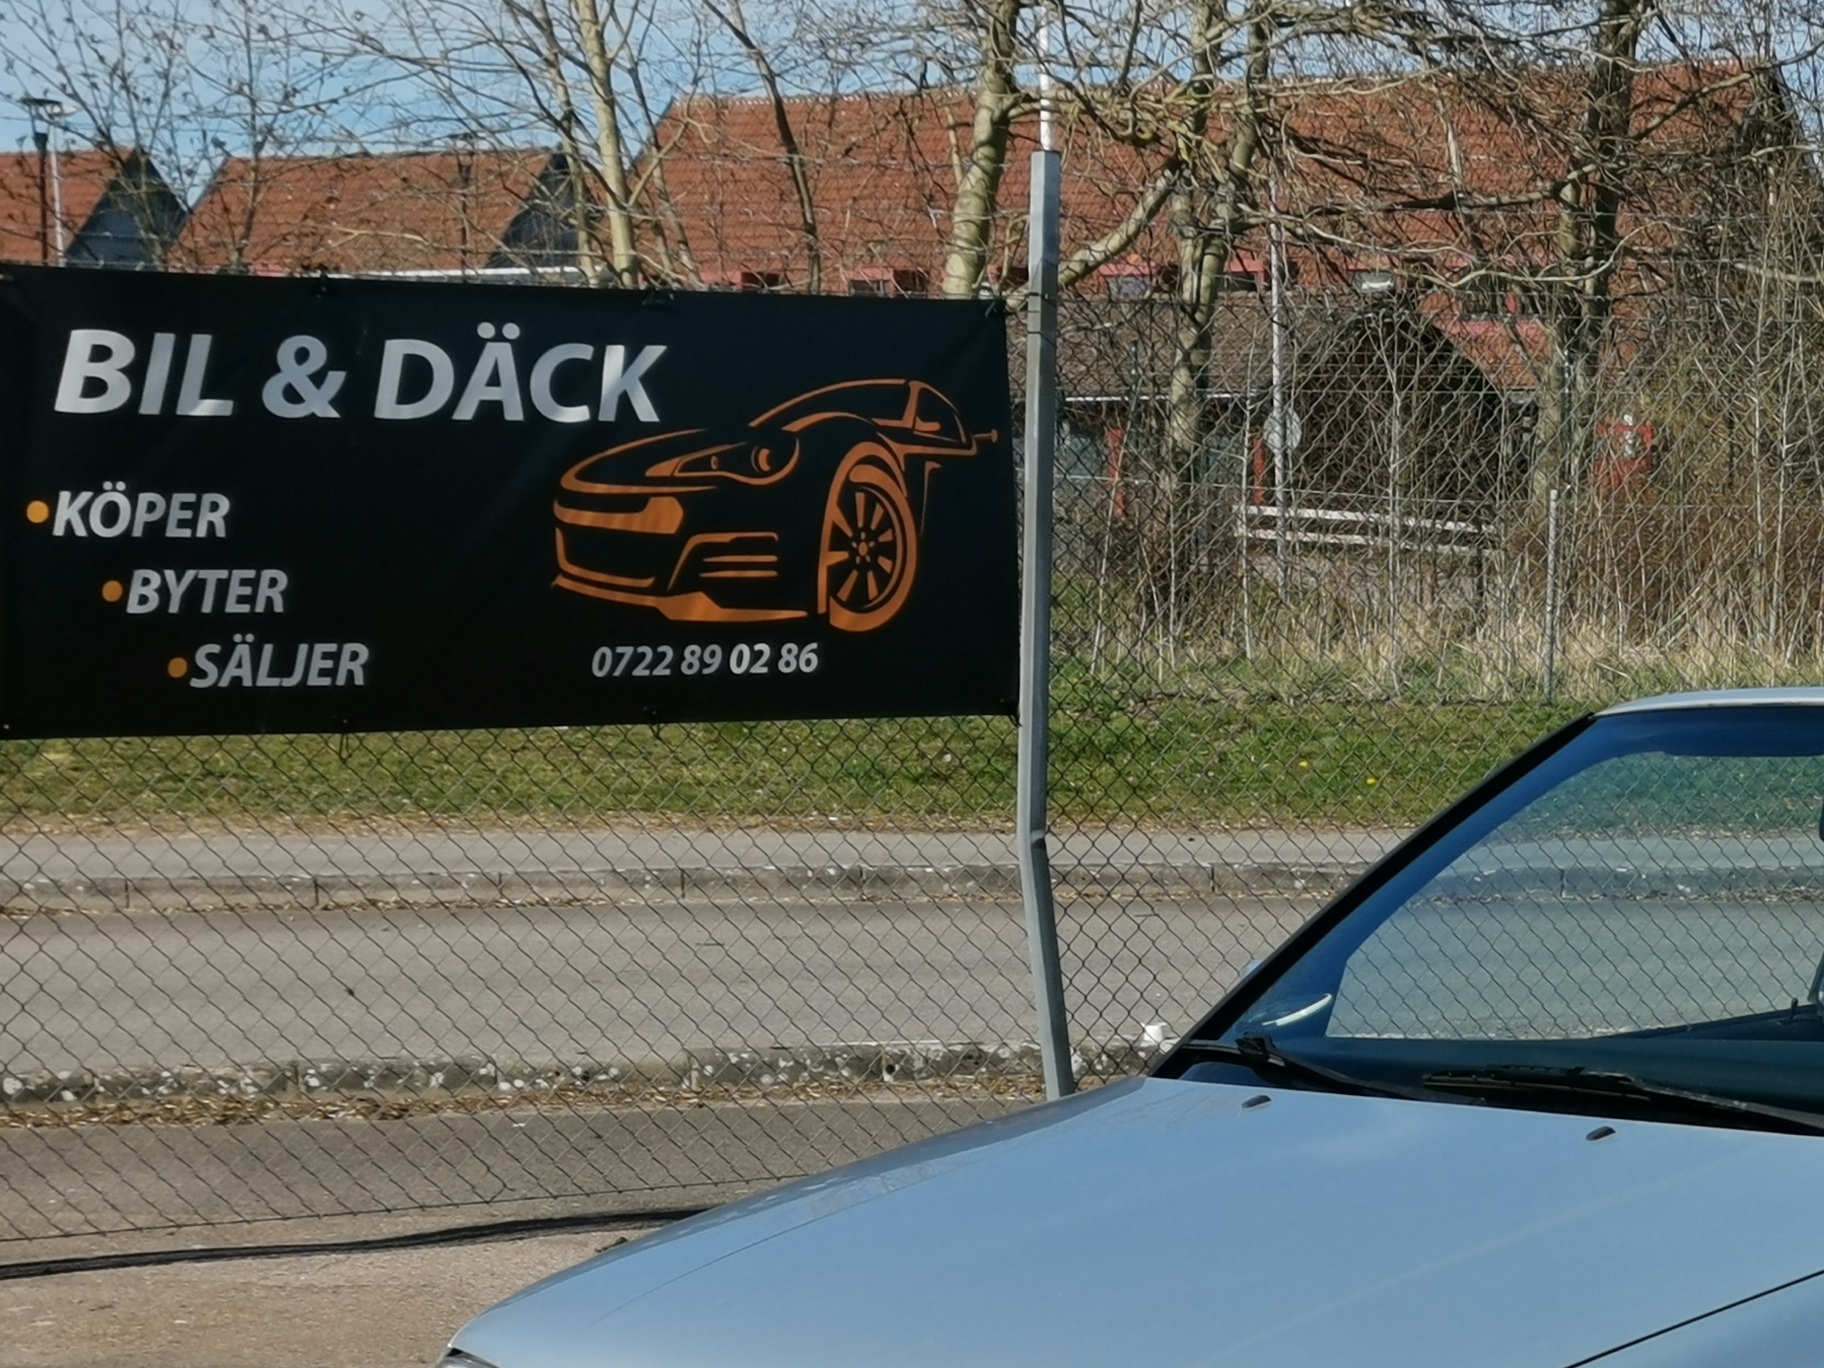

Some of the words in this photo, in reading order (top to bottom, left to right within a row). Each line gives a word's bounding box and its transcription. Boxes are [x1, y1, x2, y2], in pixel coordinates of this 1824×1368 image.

[54, 328, 234, 416] BIL
[262, 335, 347, 418] &
[374, 321, 667, 423] DÄCK
[52, 481, 231, 538] KÖPER
[126, 569, 288, 614] BYTER
[190, 633, 369, 688] SÄLJER
[591, 645, 674, 678] 0722
[680, 644, 722, 675] 89
[729, 643, 771, 674] 02
[777, 642, 819, 673] 86
